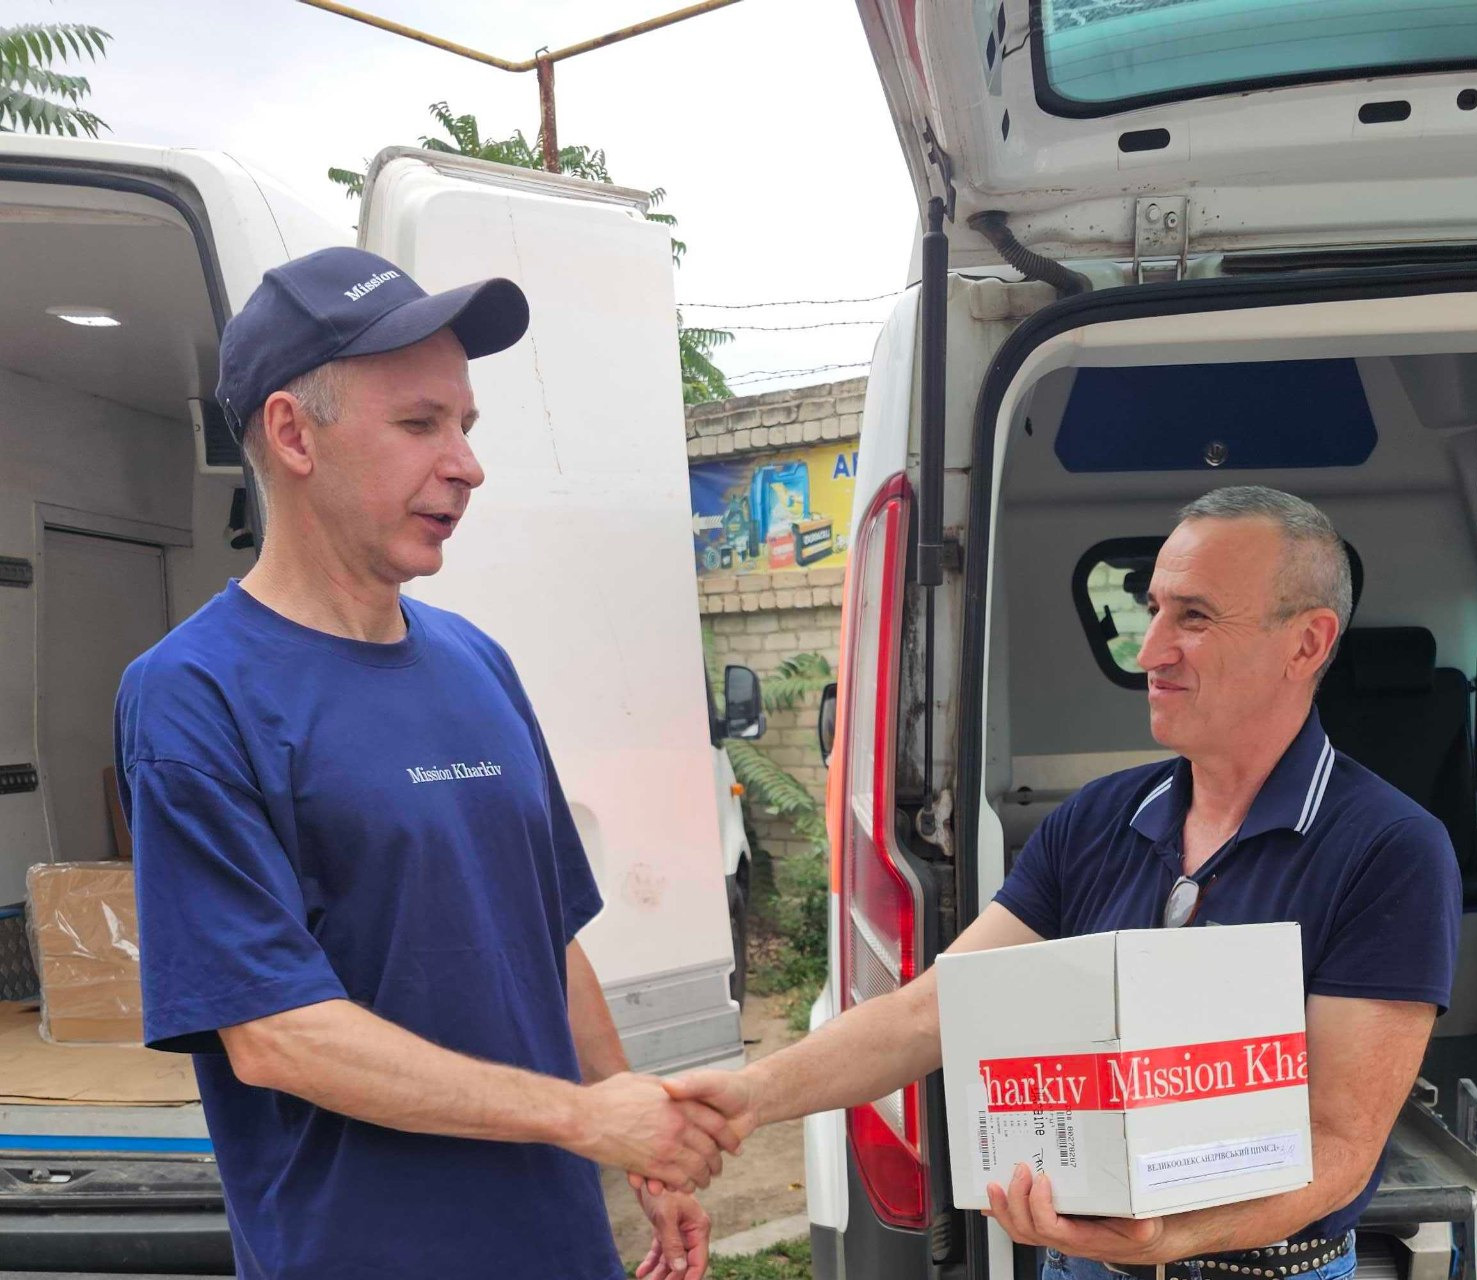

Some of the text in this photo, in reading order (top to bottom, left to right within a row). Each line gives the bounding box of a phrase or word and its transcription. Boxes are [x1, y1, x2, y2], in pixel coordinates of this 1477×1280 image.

[344, 270, 400, 301] Mission
[406, 761, 502, 783] Mission Kharkiv
[980, 1061, 1087, 1107] harkiv
[1107, 1052, 1235, 1104] Mission
